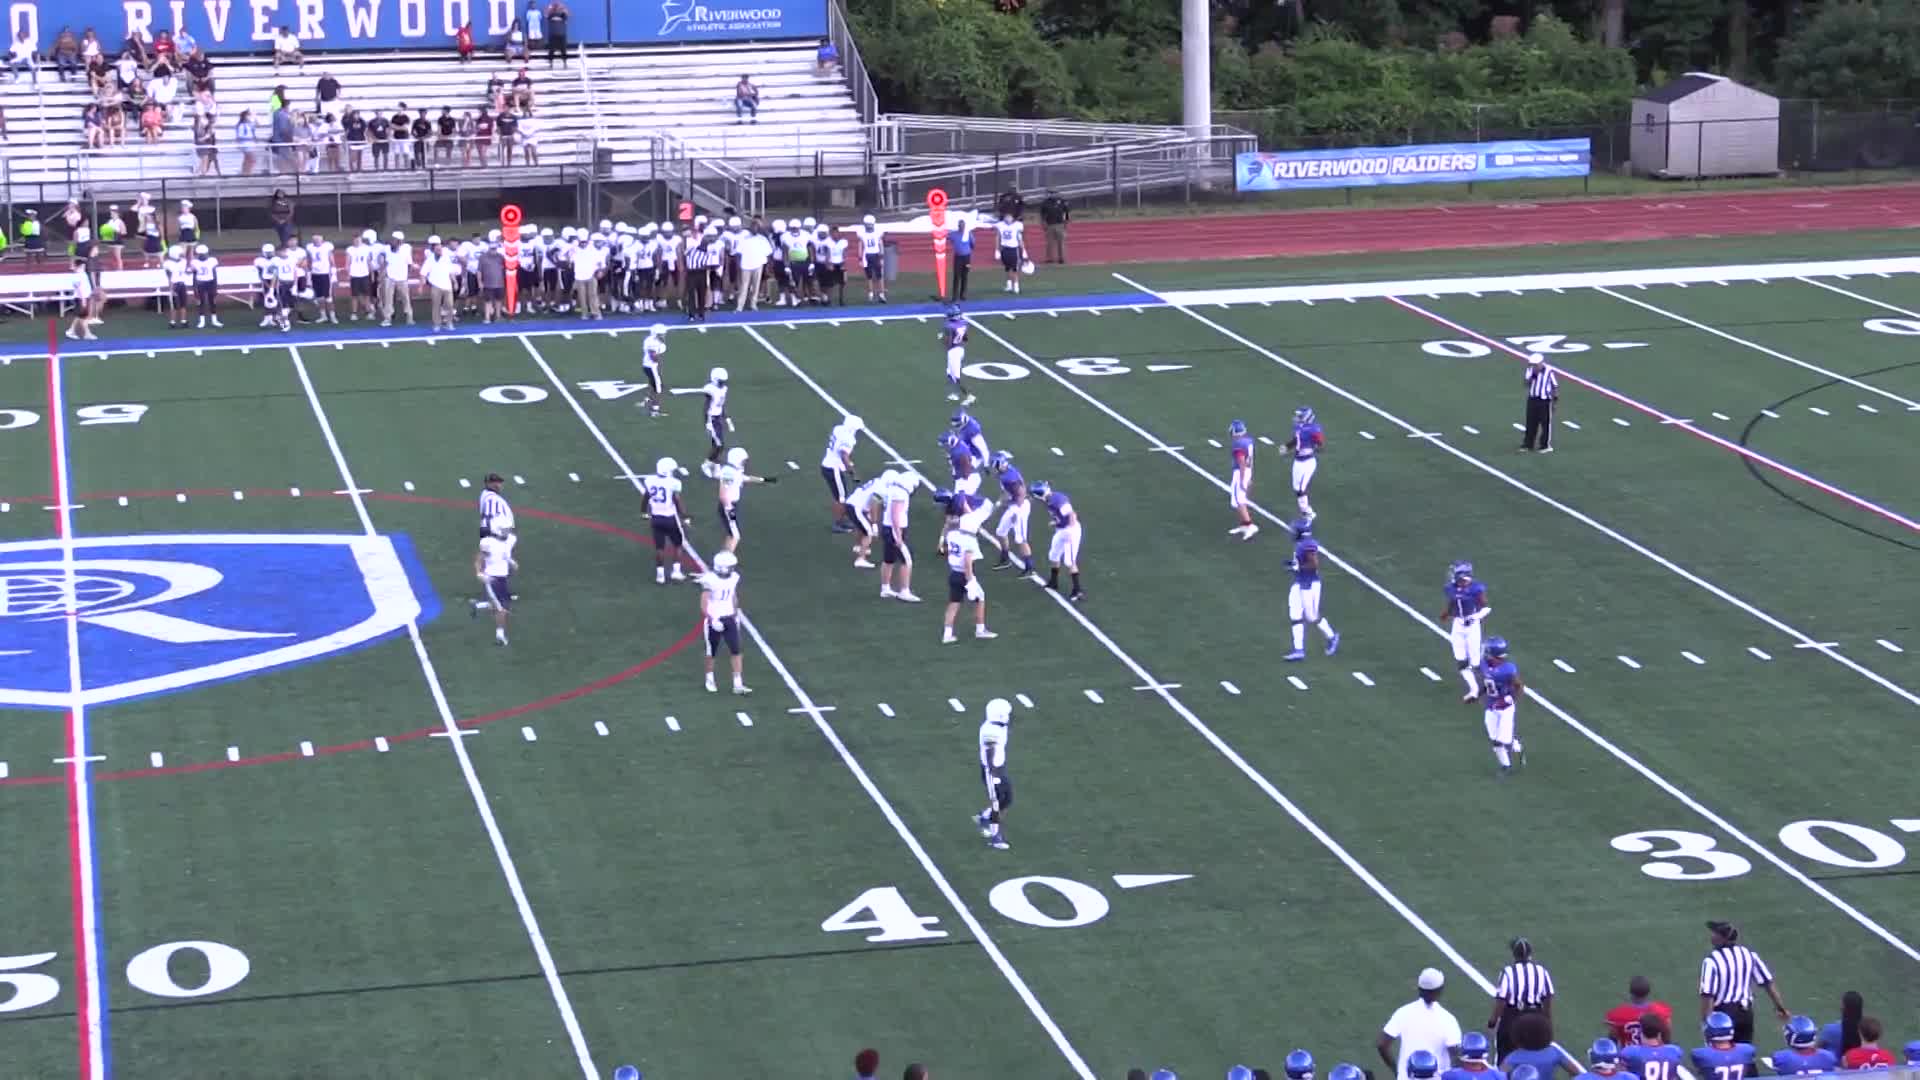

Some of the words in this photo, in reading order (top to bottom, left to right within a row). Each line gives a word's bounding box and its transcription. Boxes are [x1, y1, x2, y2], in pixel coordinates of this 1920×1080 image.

[123, 0, 514, 43] RIVERWOOD
[1272, 157, 1388, 178] RIVERWOOD
[1391, 152, 1478, 173] RAIDERS
[650, 486, 667, 503] 23
